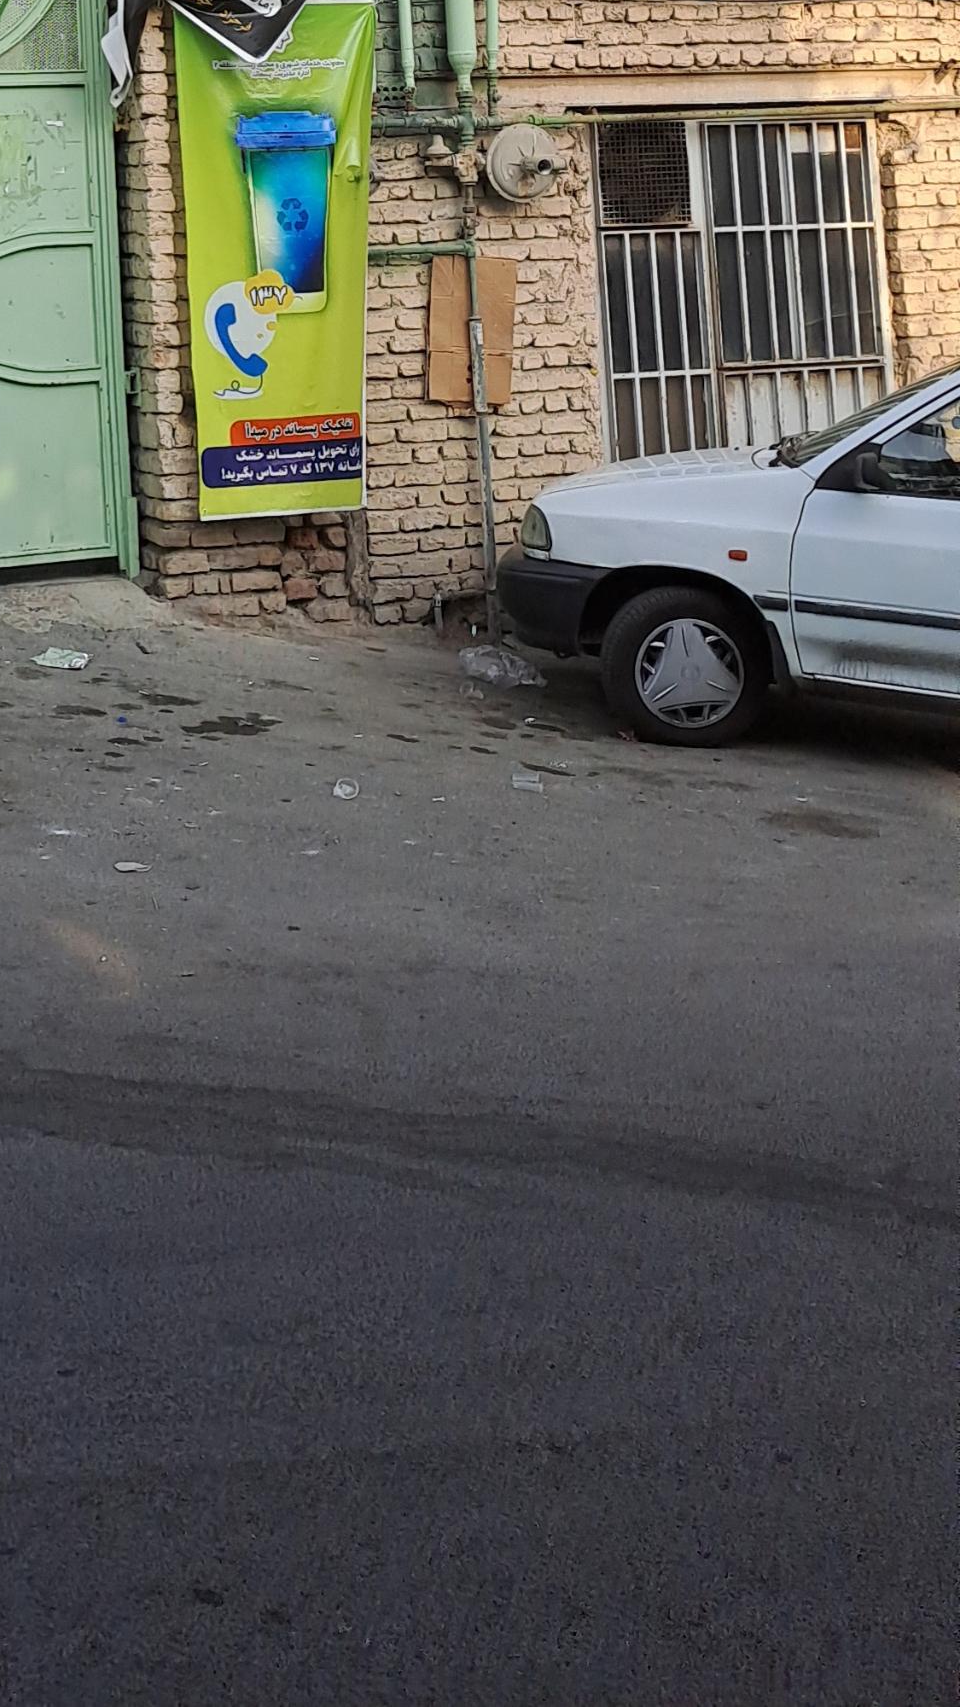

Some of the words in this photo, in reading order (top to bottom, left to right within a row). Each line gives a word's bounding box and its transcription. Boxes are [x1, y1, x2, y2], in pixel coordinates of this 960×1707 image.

[270, 426, 281, 440] در
[284, 422, 318, 438] پسماند
[320, 418, 354, 433] تفکیک
[235, 448, 265, 463] خشک
[318, 444, 347, 460] تحویل
[256, 466, 288, 480] تماس
[301, 462, 313, 475] کد
